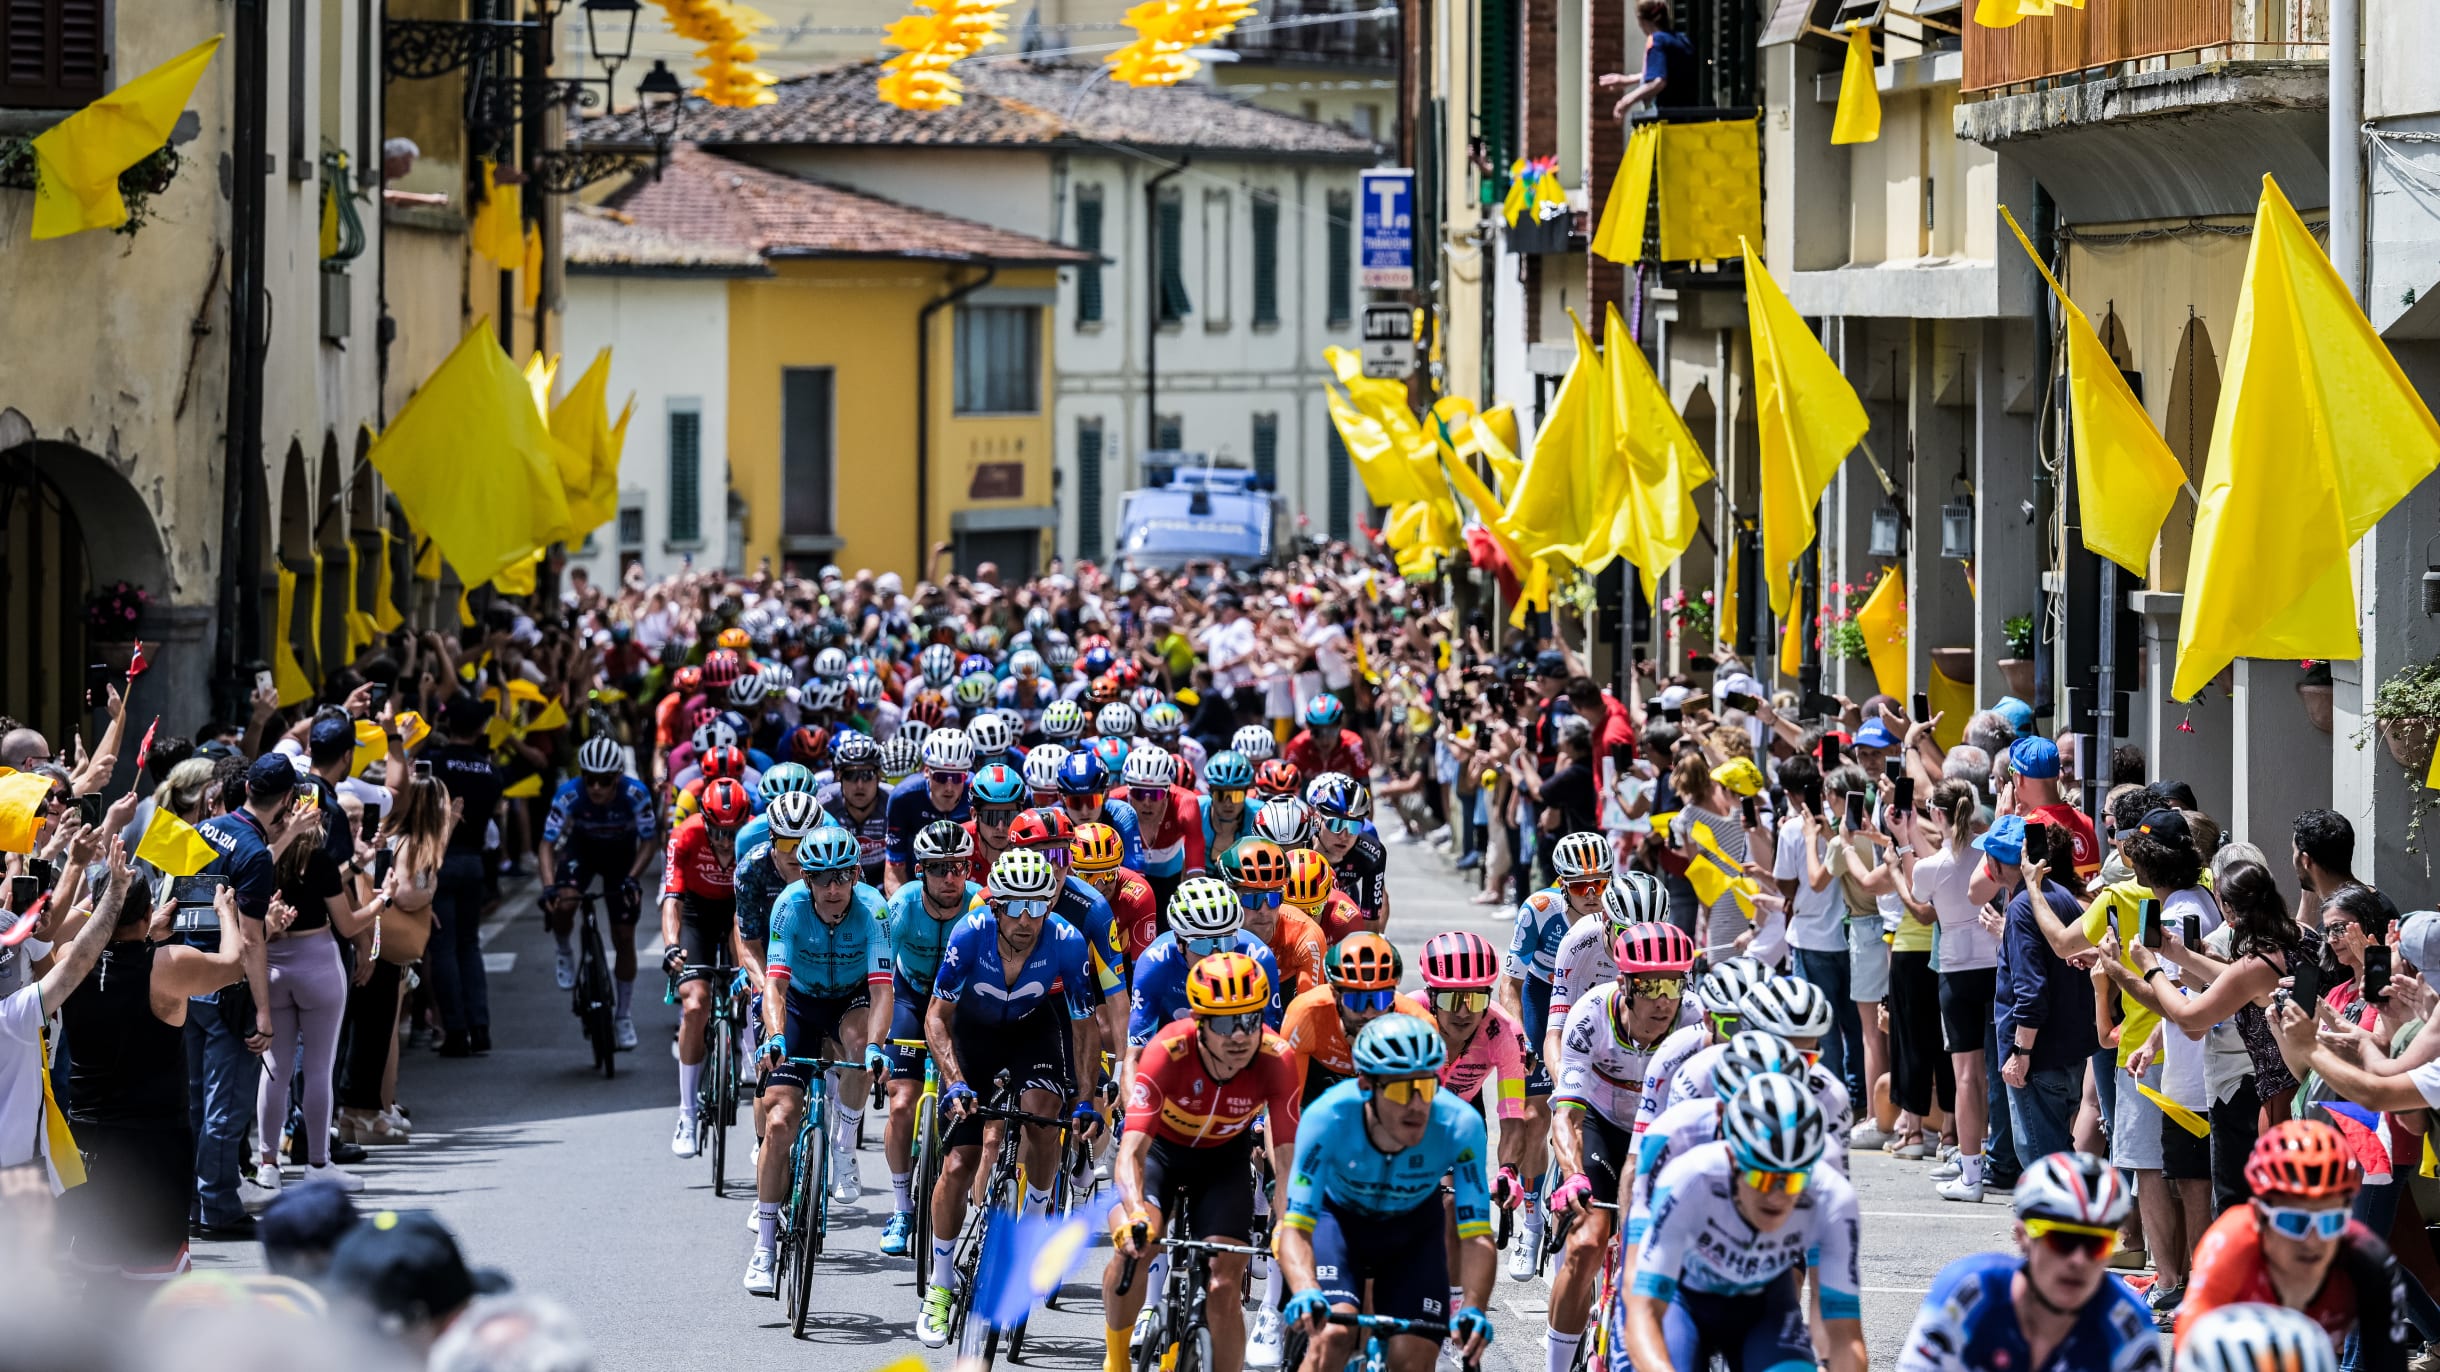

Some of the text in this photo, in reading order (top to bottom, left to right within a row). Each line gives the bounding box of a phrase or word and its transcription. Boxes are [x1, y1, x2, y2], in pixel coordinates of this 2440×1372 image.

[1369, 180, 1405, 228] T
[447, 759, 492, 774] POLIZIA
[199, 822, 238, 852] POLIZIA
[1064, 889, 1091, 909] TREK
[1374, 872, 1384, 905] BOSS
[1570, 935, 1599, 956] presight
[1126, 1083, 1150, 1108] R
[1227, 1097, 1252, 1105] REMA
[1163, 1108, 1201, 1129] Uno
[1697, 1231, 1805, 1278] BAHRAIN
